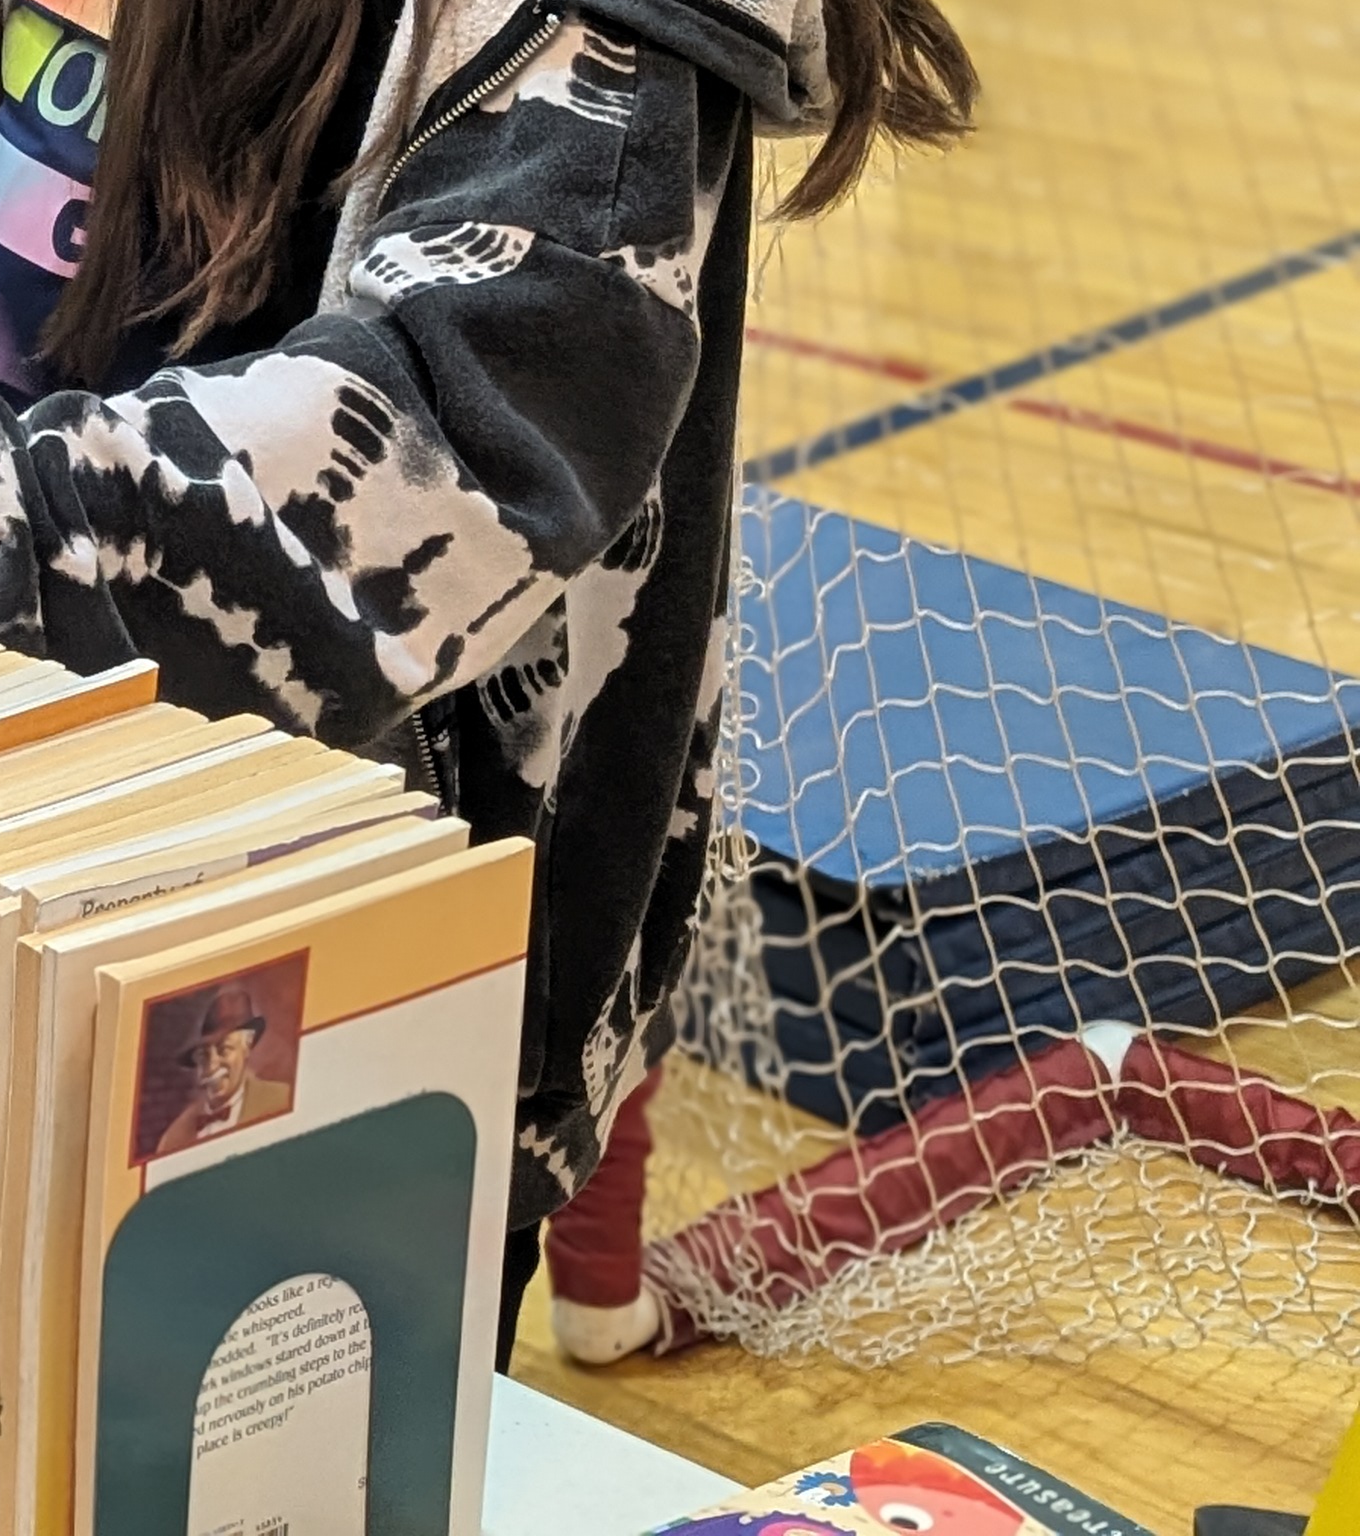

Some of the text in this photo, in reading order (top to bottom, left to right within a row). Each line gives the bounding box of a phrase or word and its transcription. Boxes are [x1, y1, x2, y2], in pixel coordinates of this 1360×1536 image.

[282, 1285, 304, 1303] like
[306, 1281, 315, 1293] a
[242, 1303, 306, 1338] whispered.
[292, 1308, 345, 1338] definitely
[214, 1392, 234, 1411] the
[236, 1367, 297, 1401] crumbling
[299, 1353, 330, 1376] steps
[333, 1348, 345, 1362] to
[348, 1339, 367, 1356] the
[221, 1359, 272, 1385] windows
[275, 1340, 312, 1364] stared
[314, 1328, 346, 1349] down
[349, 1321, 361, 1336] at
[209, 1399, 266, 1432] nervously
[268, 1392, 285, 1407] on
[287, 1383, 305, 1400] his
[307, 1368, 345, 1395] potato
[196, 1435, 230, 1460] place
[232, 1428, 243, 1443] is
[984, 1463, 1123, 1536] reasure
